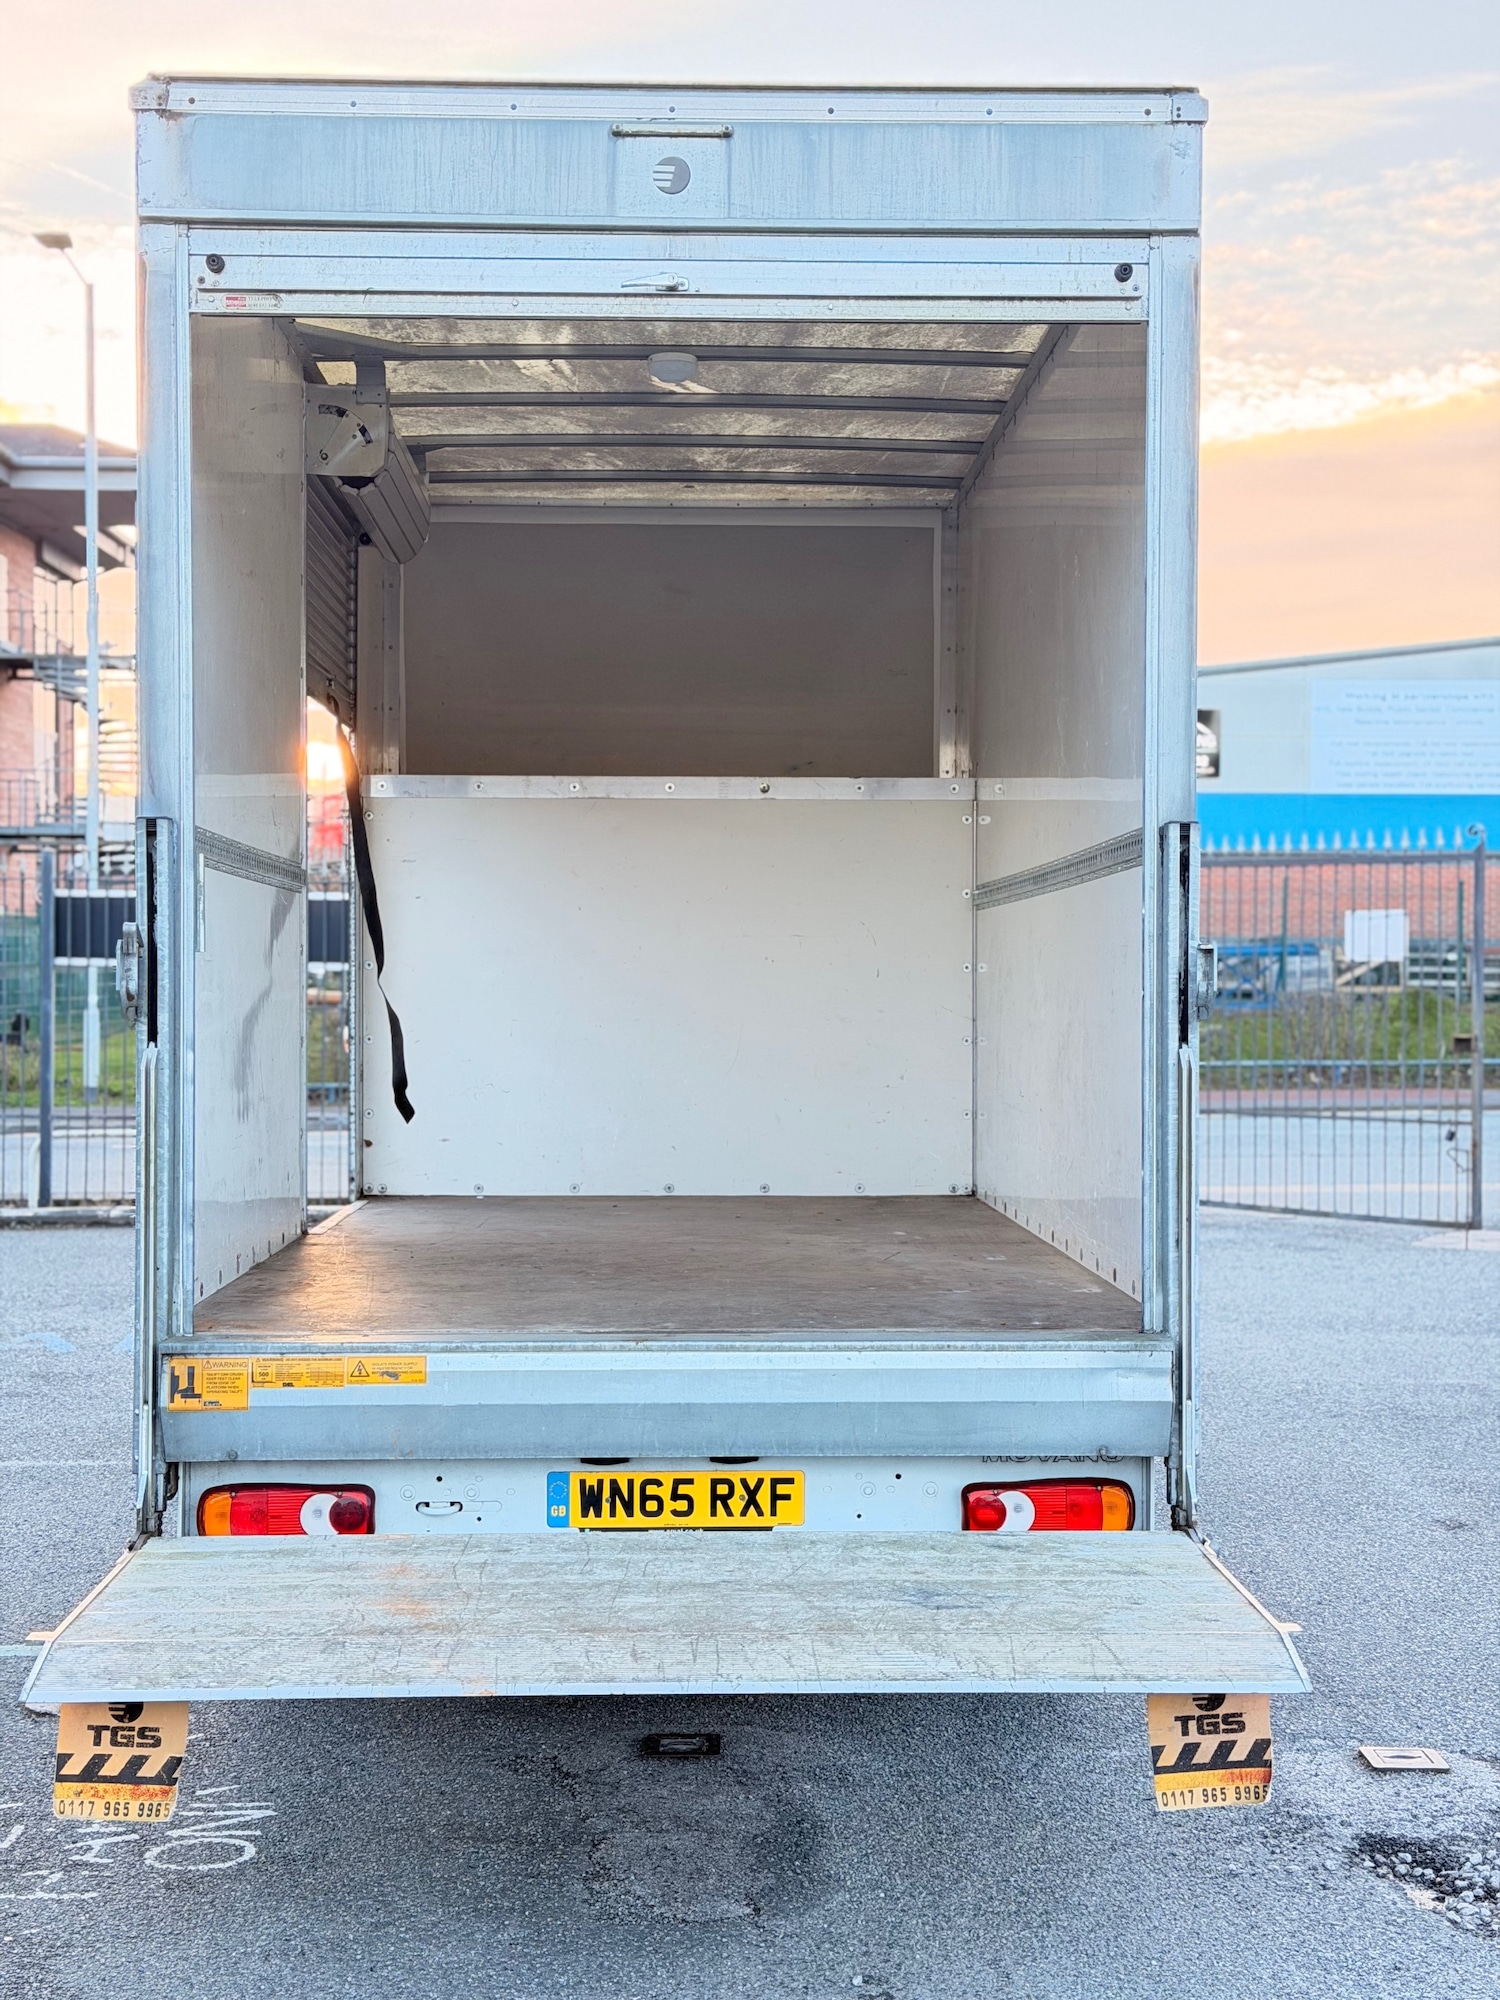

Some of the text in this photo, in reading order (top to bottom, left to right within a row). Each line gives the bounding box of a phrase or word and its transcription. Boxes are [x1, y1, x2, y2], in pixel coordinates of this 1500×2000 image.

[579, 1477, 795, 1518] WN65 RXF
[551, 1506, 567, 1517] GB
[1174, 1712, 1247, 1737] TGS
[86, 1724, 162, 1749] TGS
[1161, 1785, 1268, 1807] 0117 965 9965
[58, 1800, 171, 1818] 0117 965 9965
